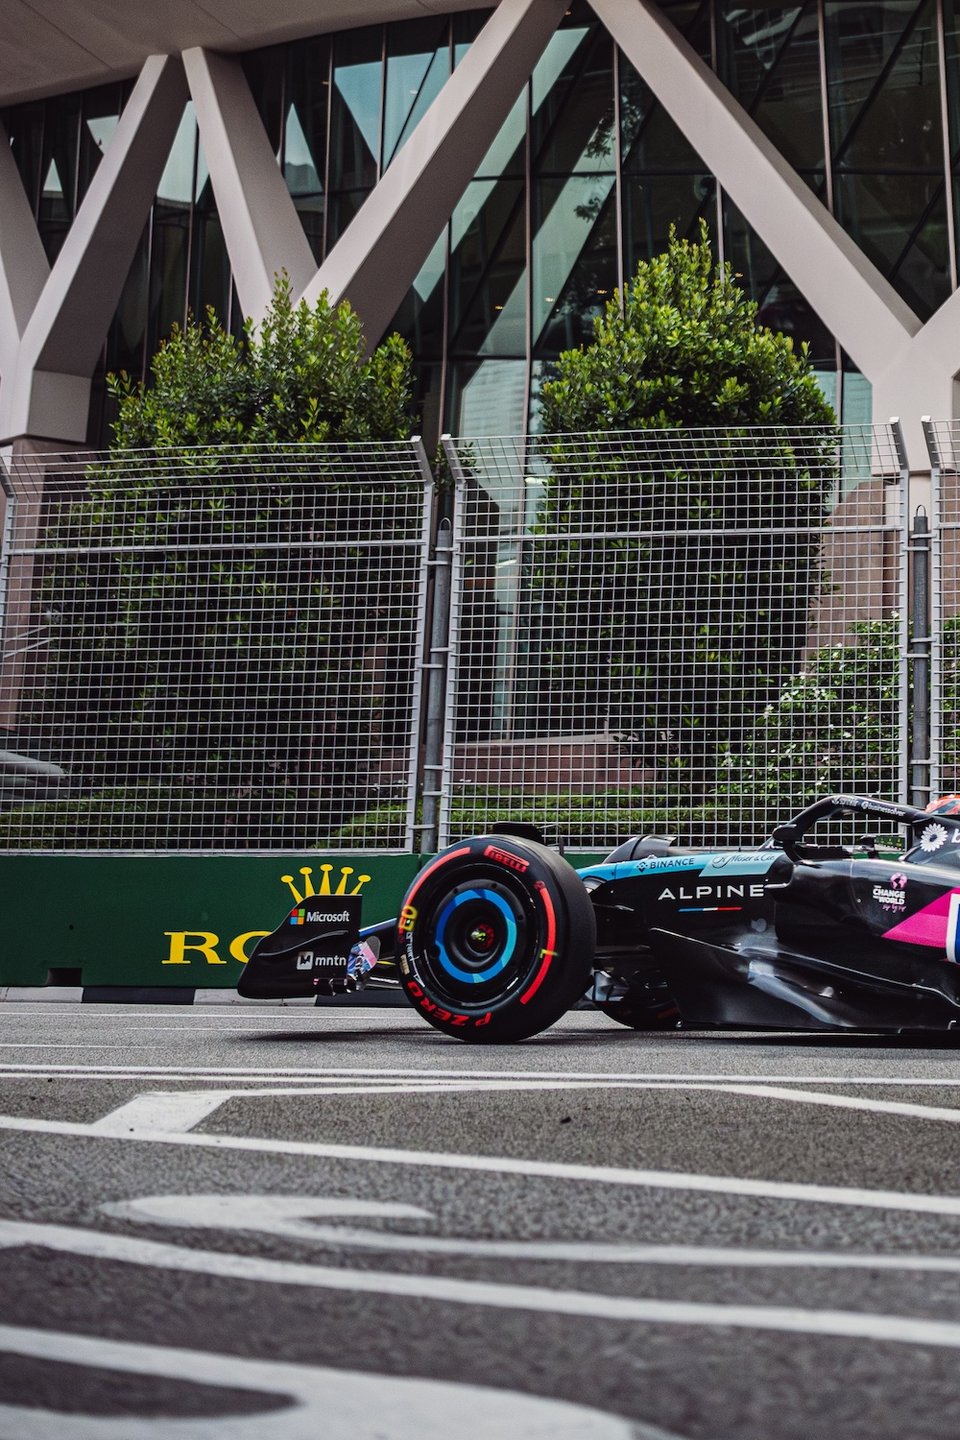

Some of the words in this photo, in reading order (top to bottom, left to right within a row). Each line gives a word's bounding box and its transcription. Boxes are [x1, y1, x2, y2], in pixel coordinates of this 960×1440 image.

[650, 858, 695, 869] BINANCE
[658, 884, 764, 901] ALPINE
[872, 889, 906, 899] CHANGE
[306, 910, 350, 922] Microsoft
[315, 954, 347, 966] mntn
[407, 981, 470, 1027] ZERO
